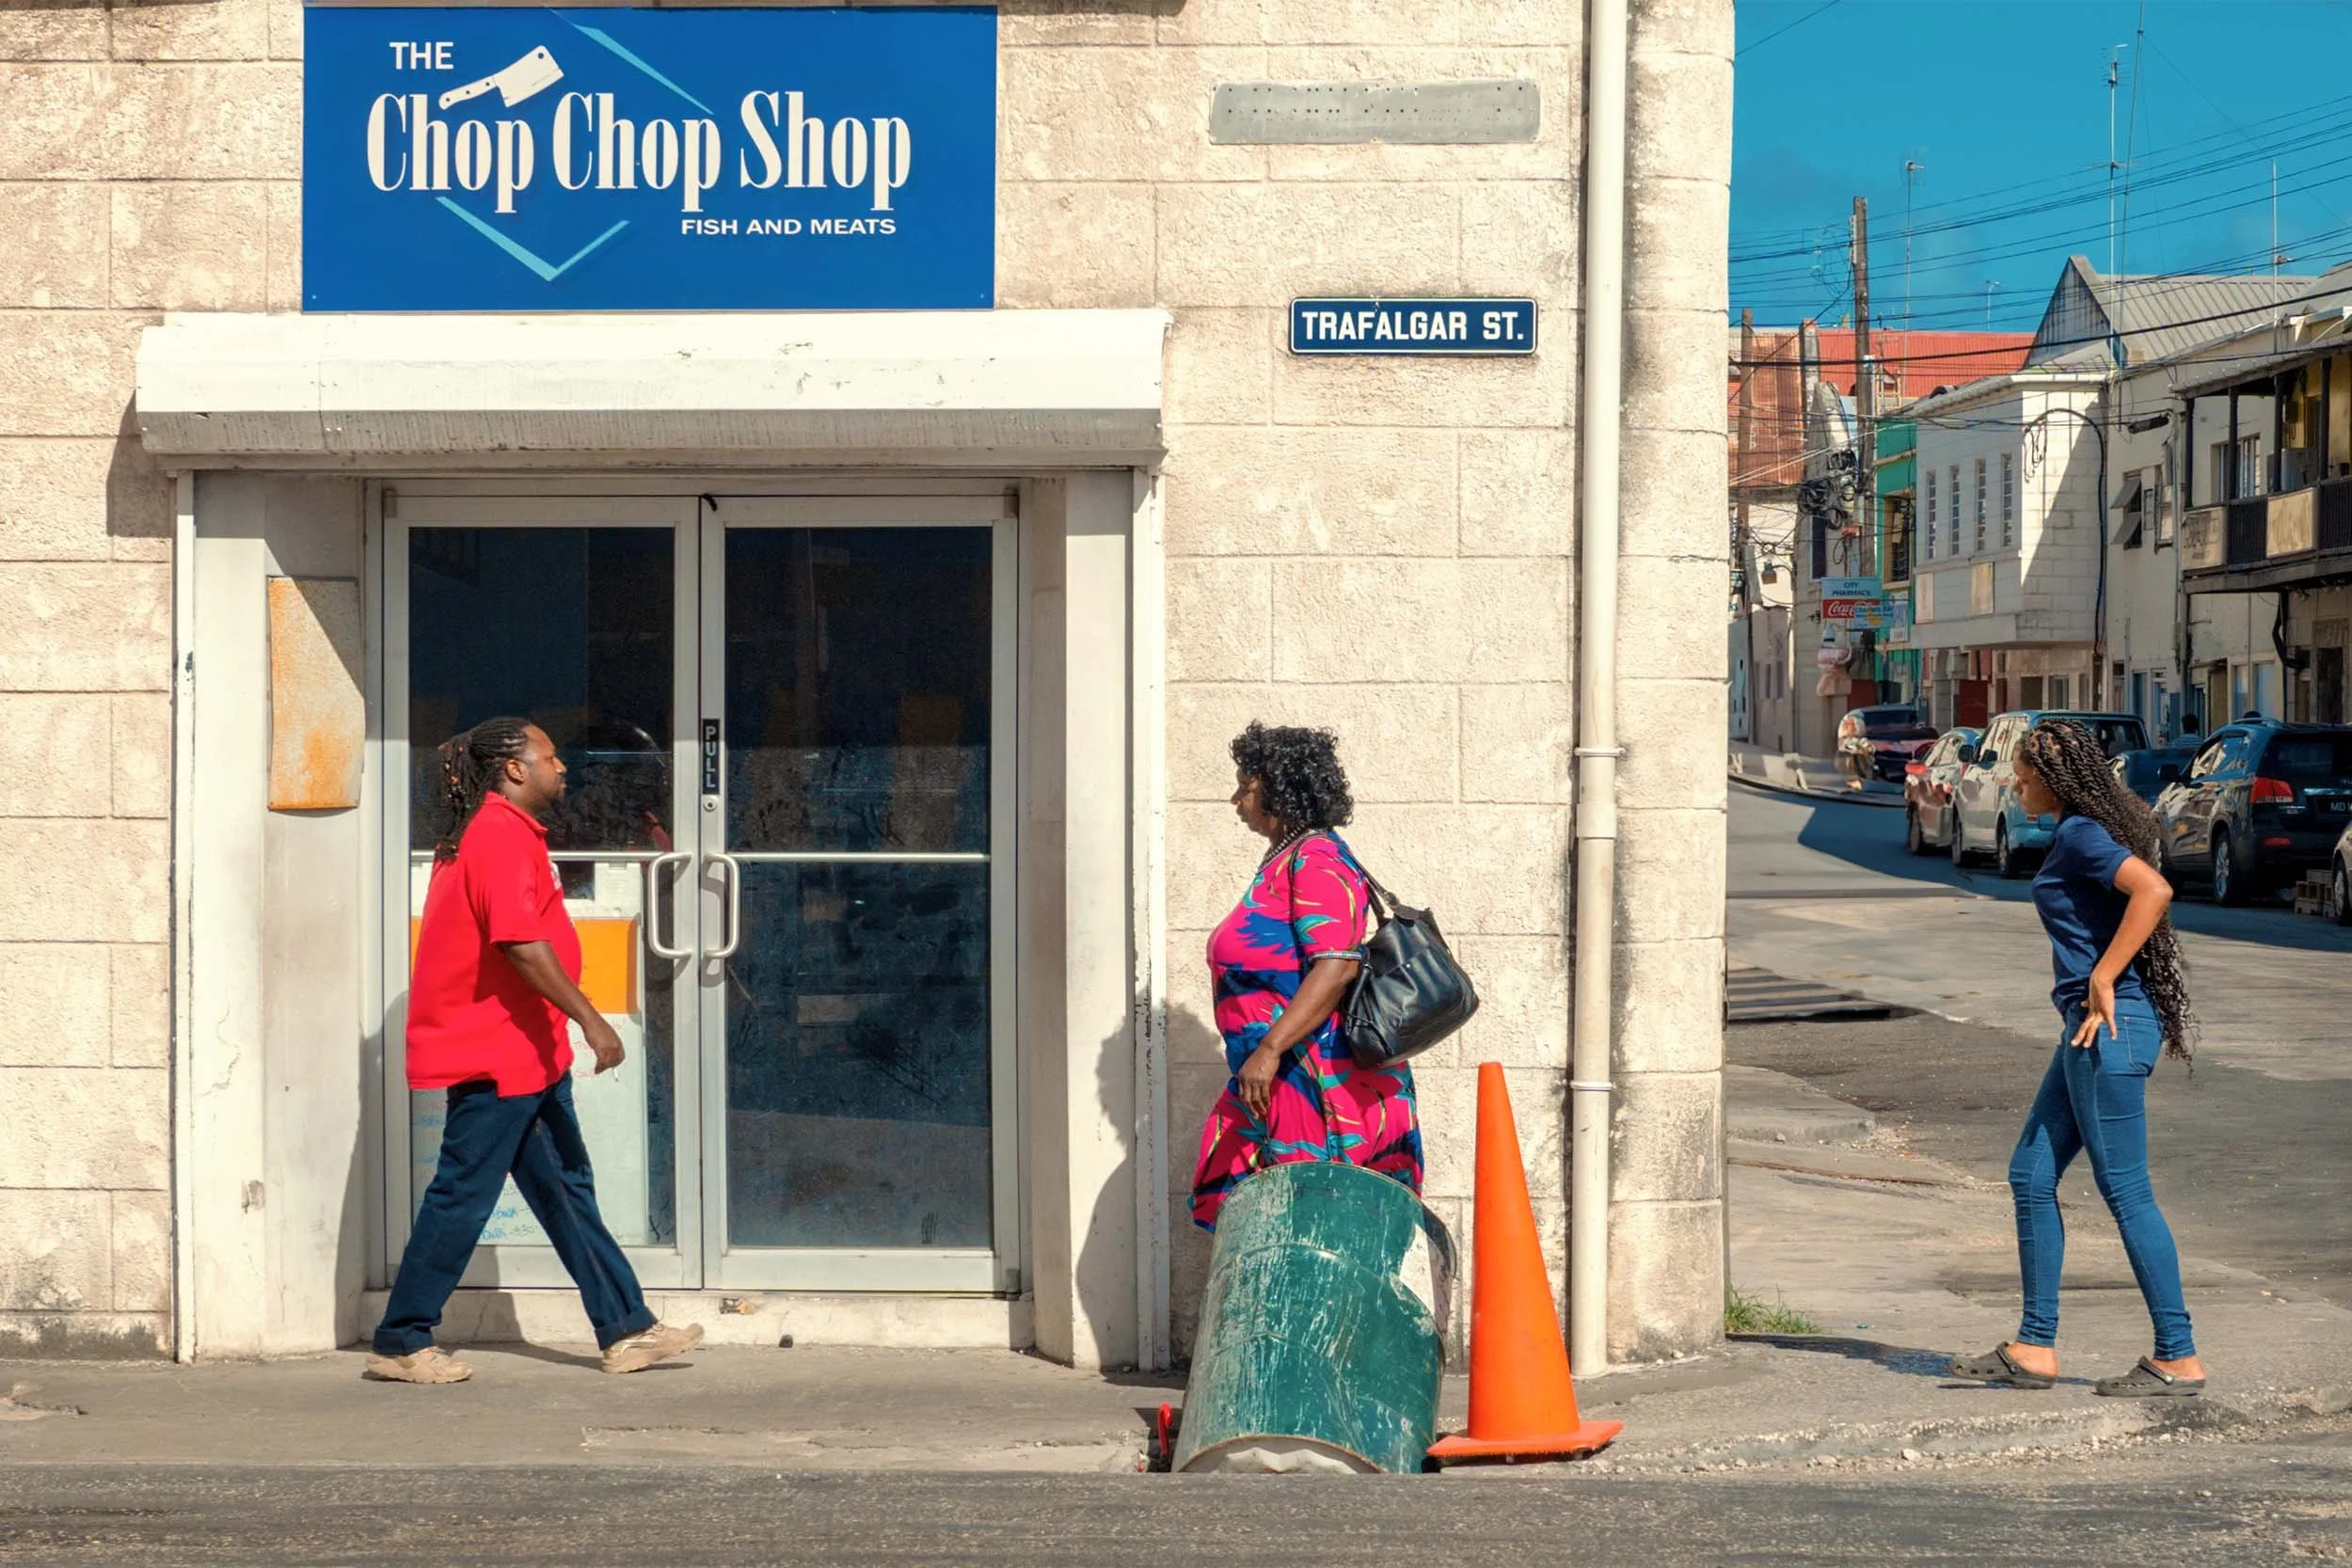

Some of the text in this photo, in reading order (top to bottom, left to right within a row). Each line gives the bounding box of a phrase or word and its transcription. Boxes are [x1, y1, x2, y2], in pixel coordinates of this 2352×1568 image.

[389, 41, 453, 70] THE
[367, 90, 911, 214] Chop Chop Shop
[681, 218, 897, 235] FISH AND MEATS
[1301, 311, 1524, 341] TRAFALGAR ST.
[705, 725, 717, 788] PULL
